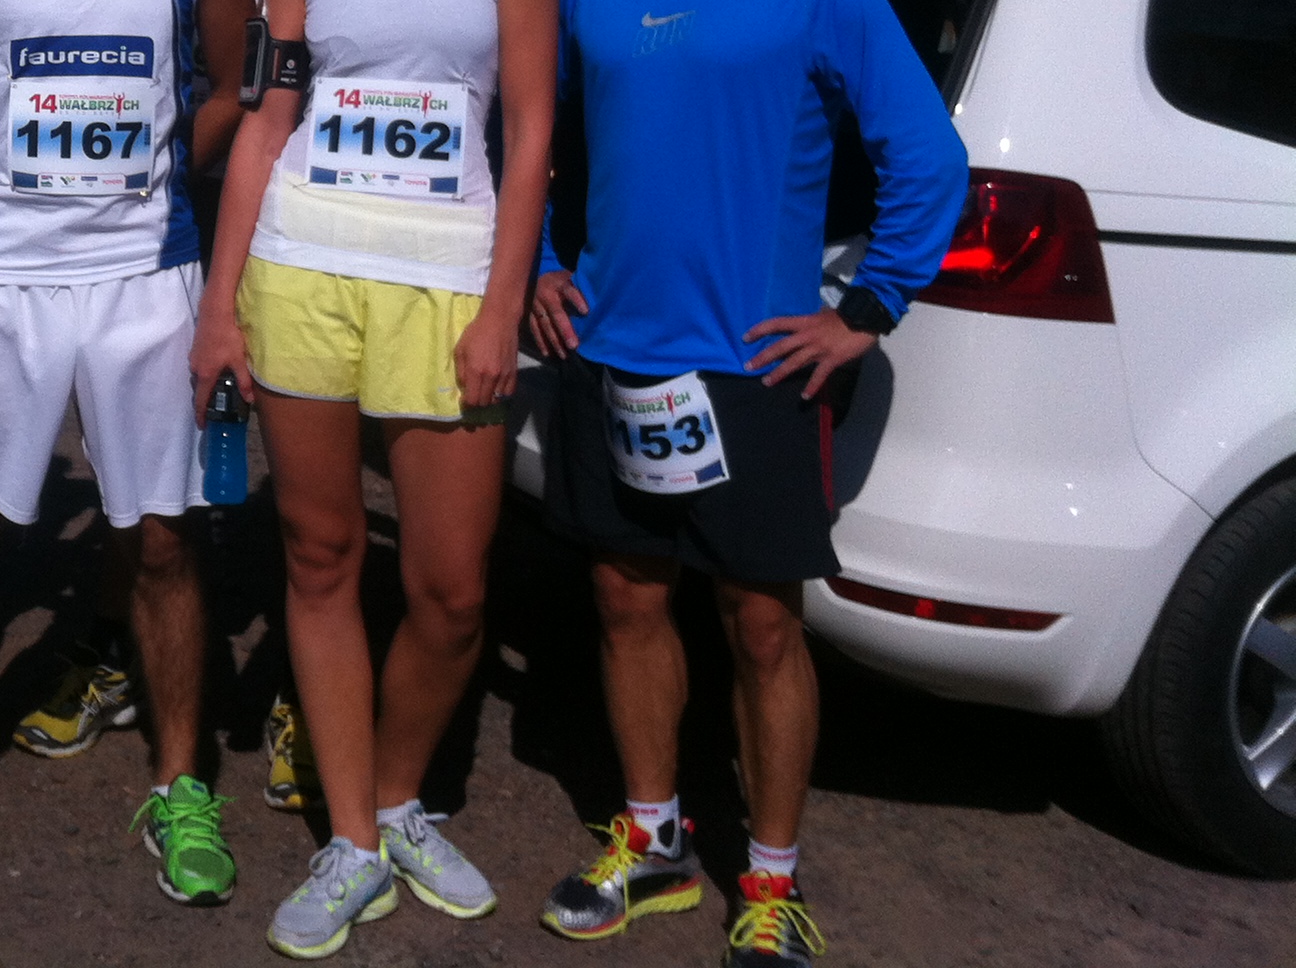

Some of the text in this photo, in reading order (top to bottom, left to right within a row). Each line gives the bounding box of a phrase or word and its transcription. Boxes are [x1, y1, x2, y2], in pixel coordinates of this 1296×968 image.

[19, 45, 146, 68] faurecia
[29, 93, 58, 114] 14
[333, 88, 362, 109] 14
[17, 119, 143, 161] 1167
[318, 114, 452, 162] 1162
